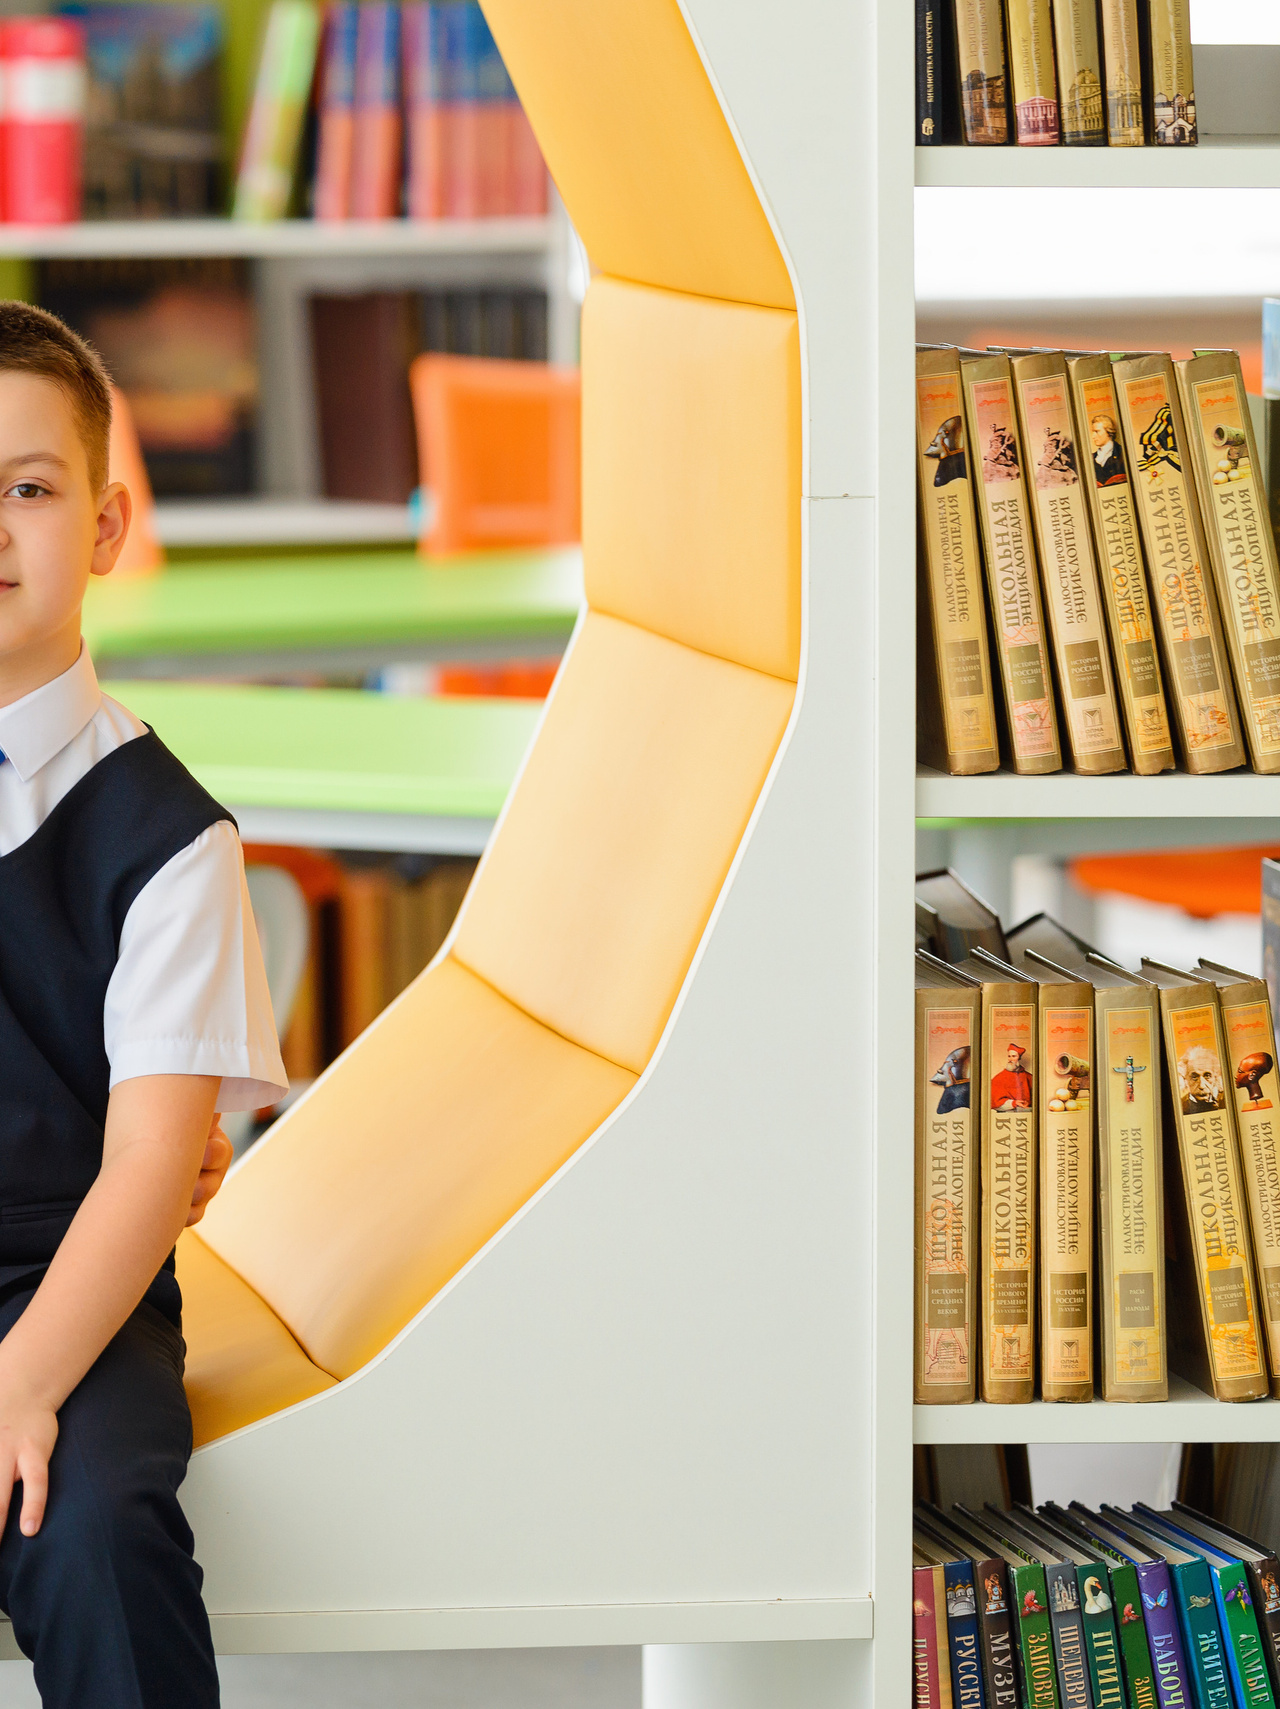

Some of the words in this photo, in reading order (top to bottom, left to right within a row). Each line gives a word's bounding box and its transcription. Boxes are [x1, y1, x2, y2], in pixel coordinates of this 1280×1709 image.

[925, 10, 933, 54] ИСКУССТВА
[926, 55, 934, 103] БИБЛИОТЕКА
[1021, 36, 1031, 88] ЖИВОПИСИ
[1072, 0, 1082, 57] ЖИВОПИСИ
[1163, 40, 1173, 92] ЖИВОПИСИ
[1174, 21, 1185, 91] ЭНЦИКЛОПЕДИЯ
[936, 496, 957, 623] ИЛЛЮСТРИРОВАННАЯ
[948, 494, 970, 622] ЭНЦИКЛОПЕДИЯ
[991, 500, 1021, 628] ШКОЛЬНАЯ
[1007, 498, 1033, 627] ЭНЦИКЛОПЕДИЯ
[1049, 499, 1075, 625] ИЛЛЮСТРИРОВАННАЯ
[1059, 496, 1087, 624] ЭНЦИКЛОПЕДИЯ
[1101, 497, 1135, 624] ШКОЛЬНАЯ
[1117, 495, 1147, 623] ЭНЦИКЛОПЕДИЯ
[1149, 488, 1189, 630] ШКОЛЬНАЯ
[1167, 485, 1205, 627] ЭНЦИКЛОПЕДИЯ
[1219, 491, 1259, 632] ШКОЛЬНАЯ
[1238, 488, 1275, 629] ЭНЦИКЛОПЕДИЯ
[1070, 656, 1099, 665] ИСТОРИЯ
[1071, 664, 1100, 674] РОССИИ
[931, 1120, 948, 1262] ШКОЛЬНАЯ
[951, 1120, 967, 1262] ЭНЦИКЛОПЕДИЯ
[995, 1117, 1012, 1258] ШКОЛЬНАЯ
[1015, 1117, 1031, 1259] ЭНЦИКЛОПЕДИЯ
[1056, 1128, 1066, 1255] ИЛЛЮСТРИРОВАННАЯ
[1067, 1127, 1082, 1255] ЭНЦИКЛОПЕДИЯ
[1120, 1128, 1132, 1255] ИЛЛЮСТРИРОВАННАЯ
[1131, 1127, 1147, 1255] ЭНЦИКЛОПЕДИЯ
[1190, 1118, 1223, 1258] ШКОЛЬНАЯ
[1209, 1115, 1239, 1257] ЭНЦИКЛОПЕДИЯ
[1250, 1123, 1275, 1248] ИЛЛЮСТРИРОВАННАЯ
[1053, 1288, 1086, 1296] ИСТОРИЯ
[1214, 1291, 1244, 1300] ИСТОРИЯ
[913, 1637, 931, 1709] ПАРУСН
[989, 1631, 1017, 1709] МУЗЕ
[1058, 1624, 1088, 1709] ШЕДЕВР
[1092, 1628, 1122, 1709] ПТИЦ
[1152, 1631, 1186, 1709] БАБОЧ
[1238, 1633, 1270, 1706] САМЫЕ
